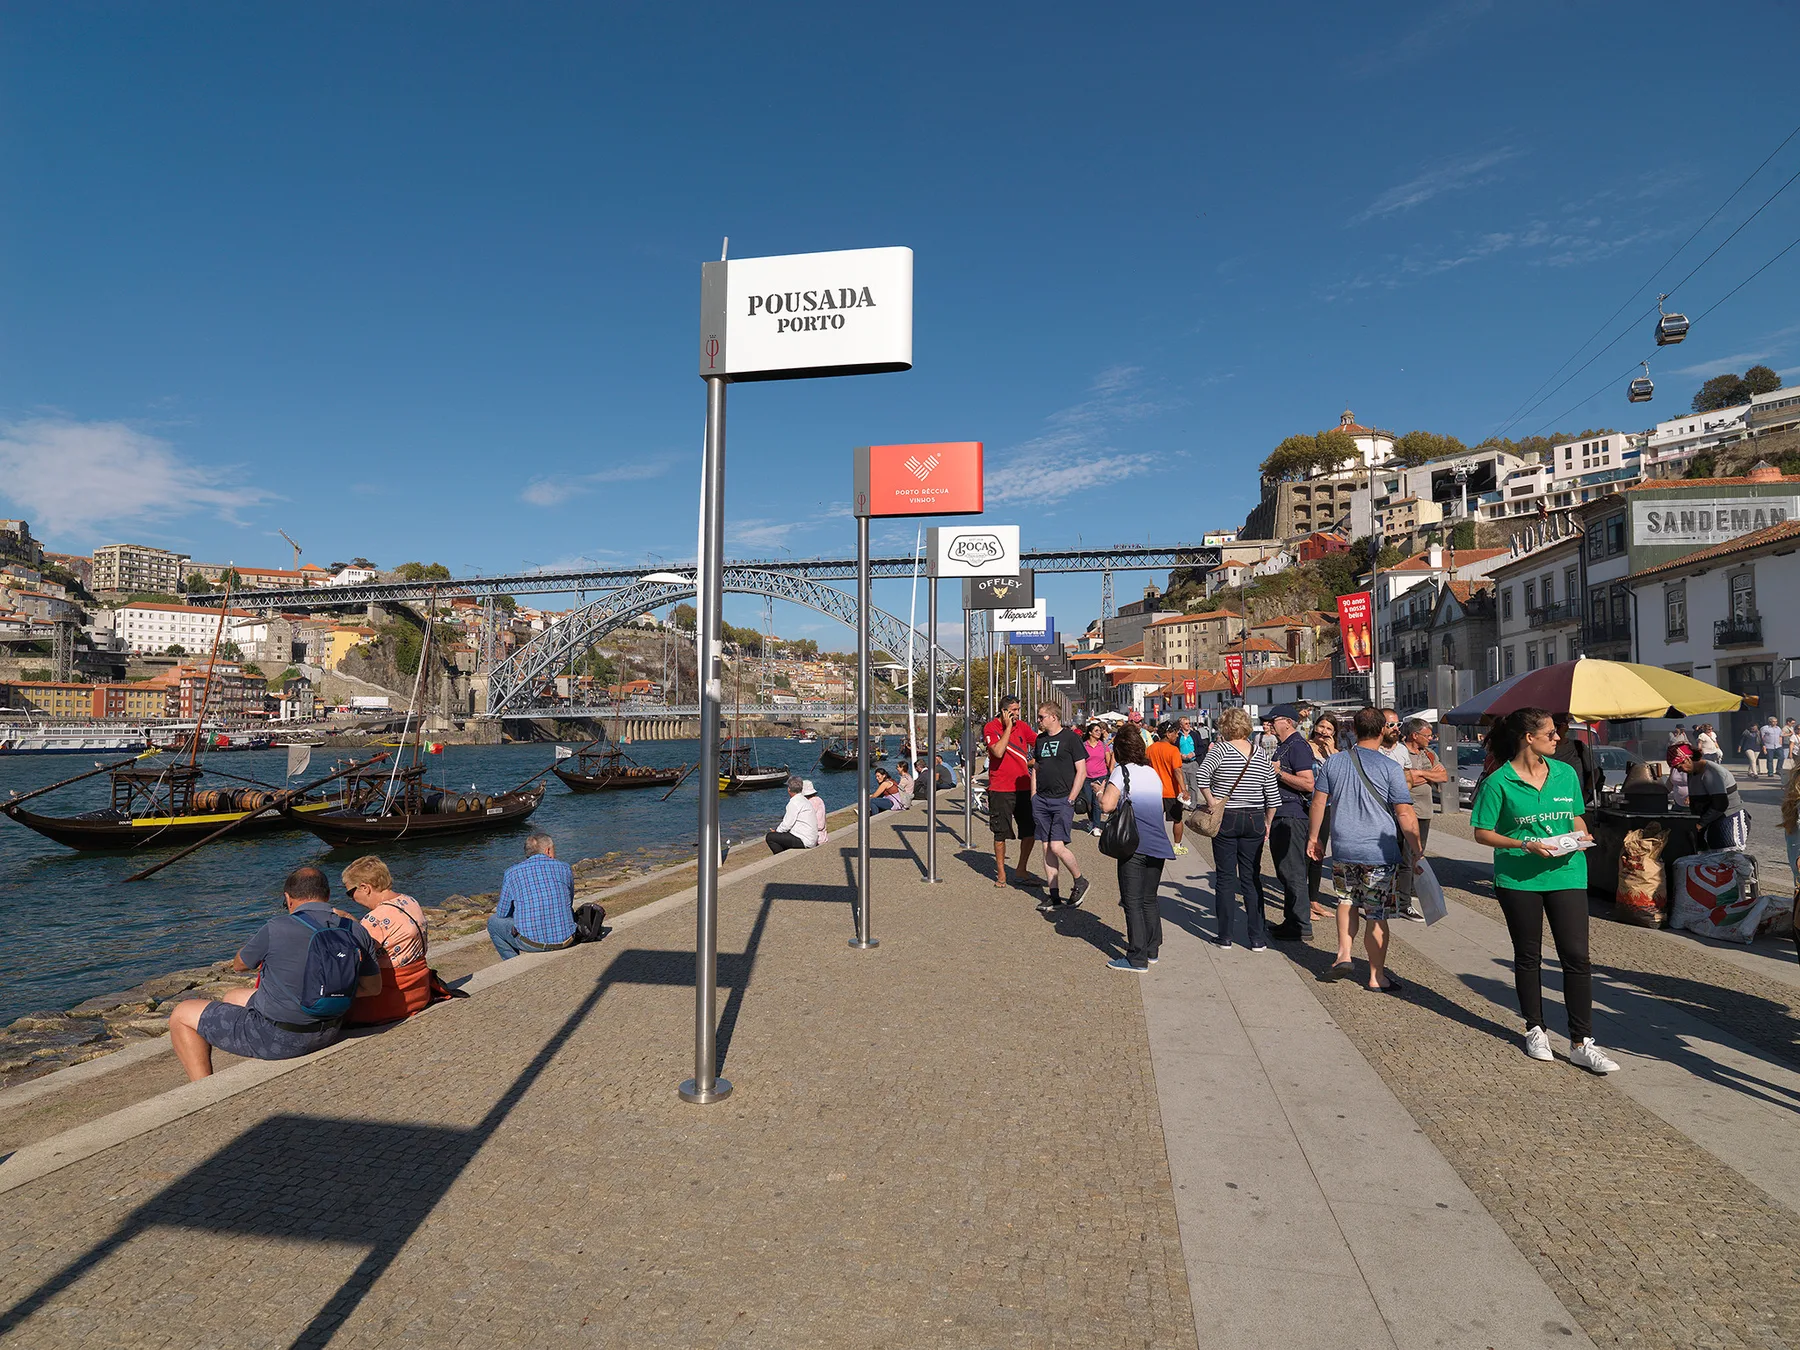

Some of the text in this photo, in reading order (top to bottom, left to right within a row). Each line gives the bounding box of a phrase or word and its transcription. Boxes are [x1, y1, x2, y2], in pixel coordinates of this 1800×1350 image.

[747, 286, 876, 317] POUSADA
[777, 313, 846, 334] PORTO
[1647, 508, 1787, 533] SANDEMAN
[955, 541, 998, 557] POÇAS
[978, 578, 1023, 590] OFFLEY
[1342, 598, 1366, 607] 90 anos
[1514, 814, 1537, 825] FREE
